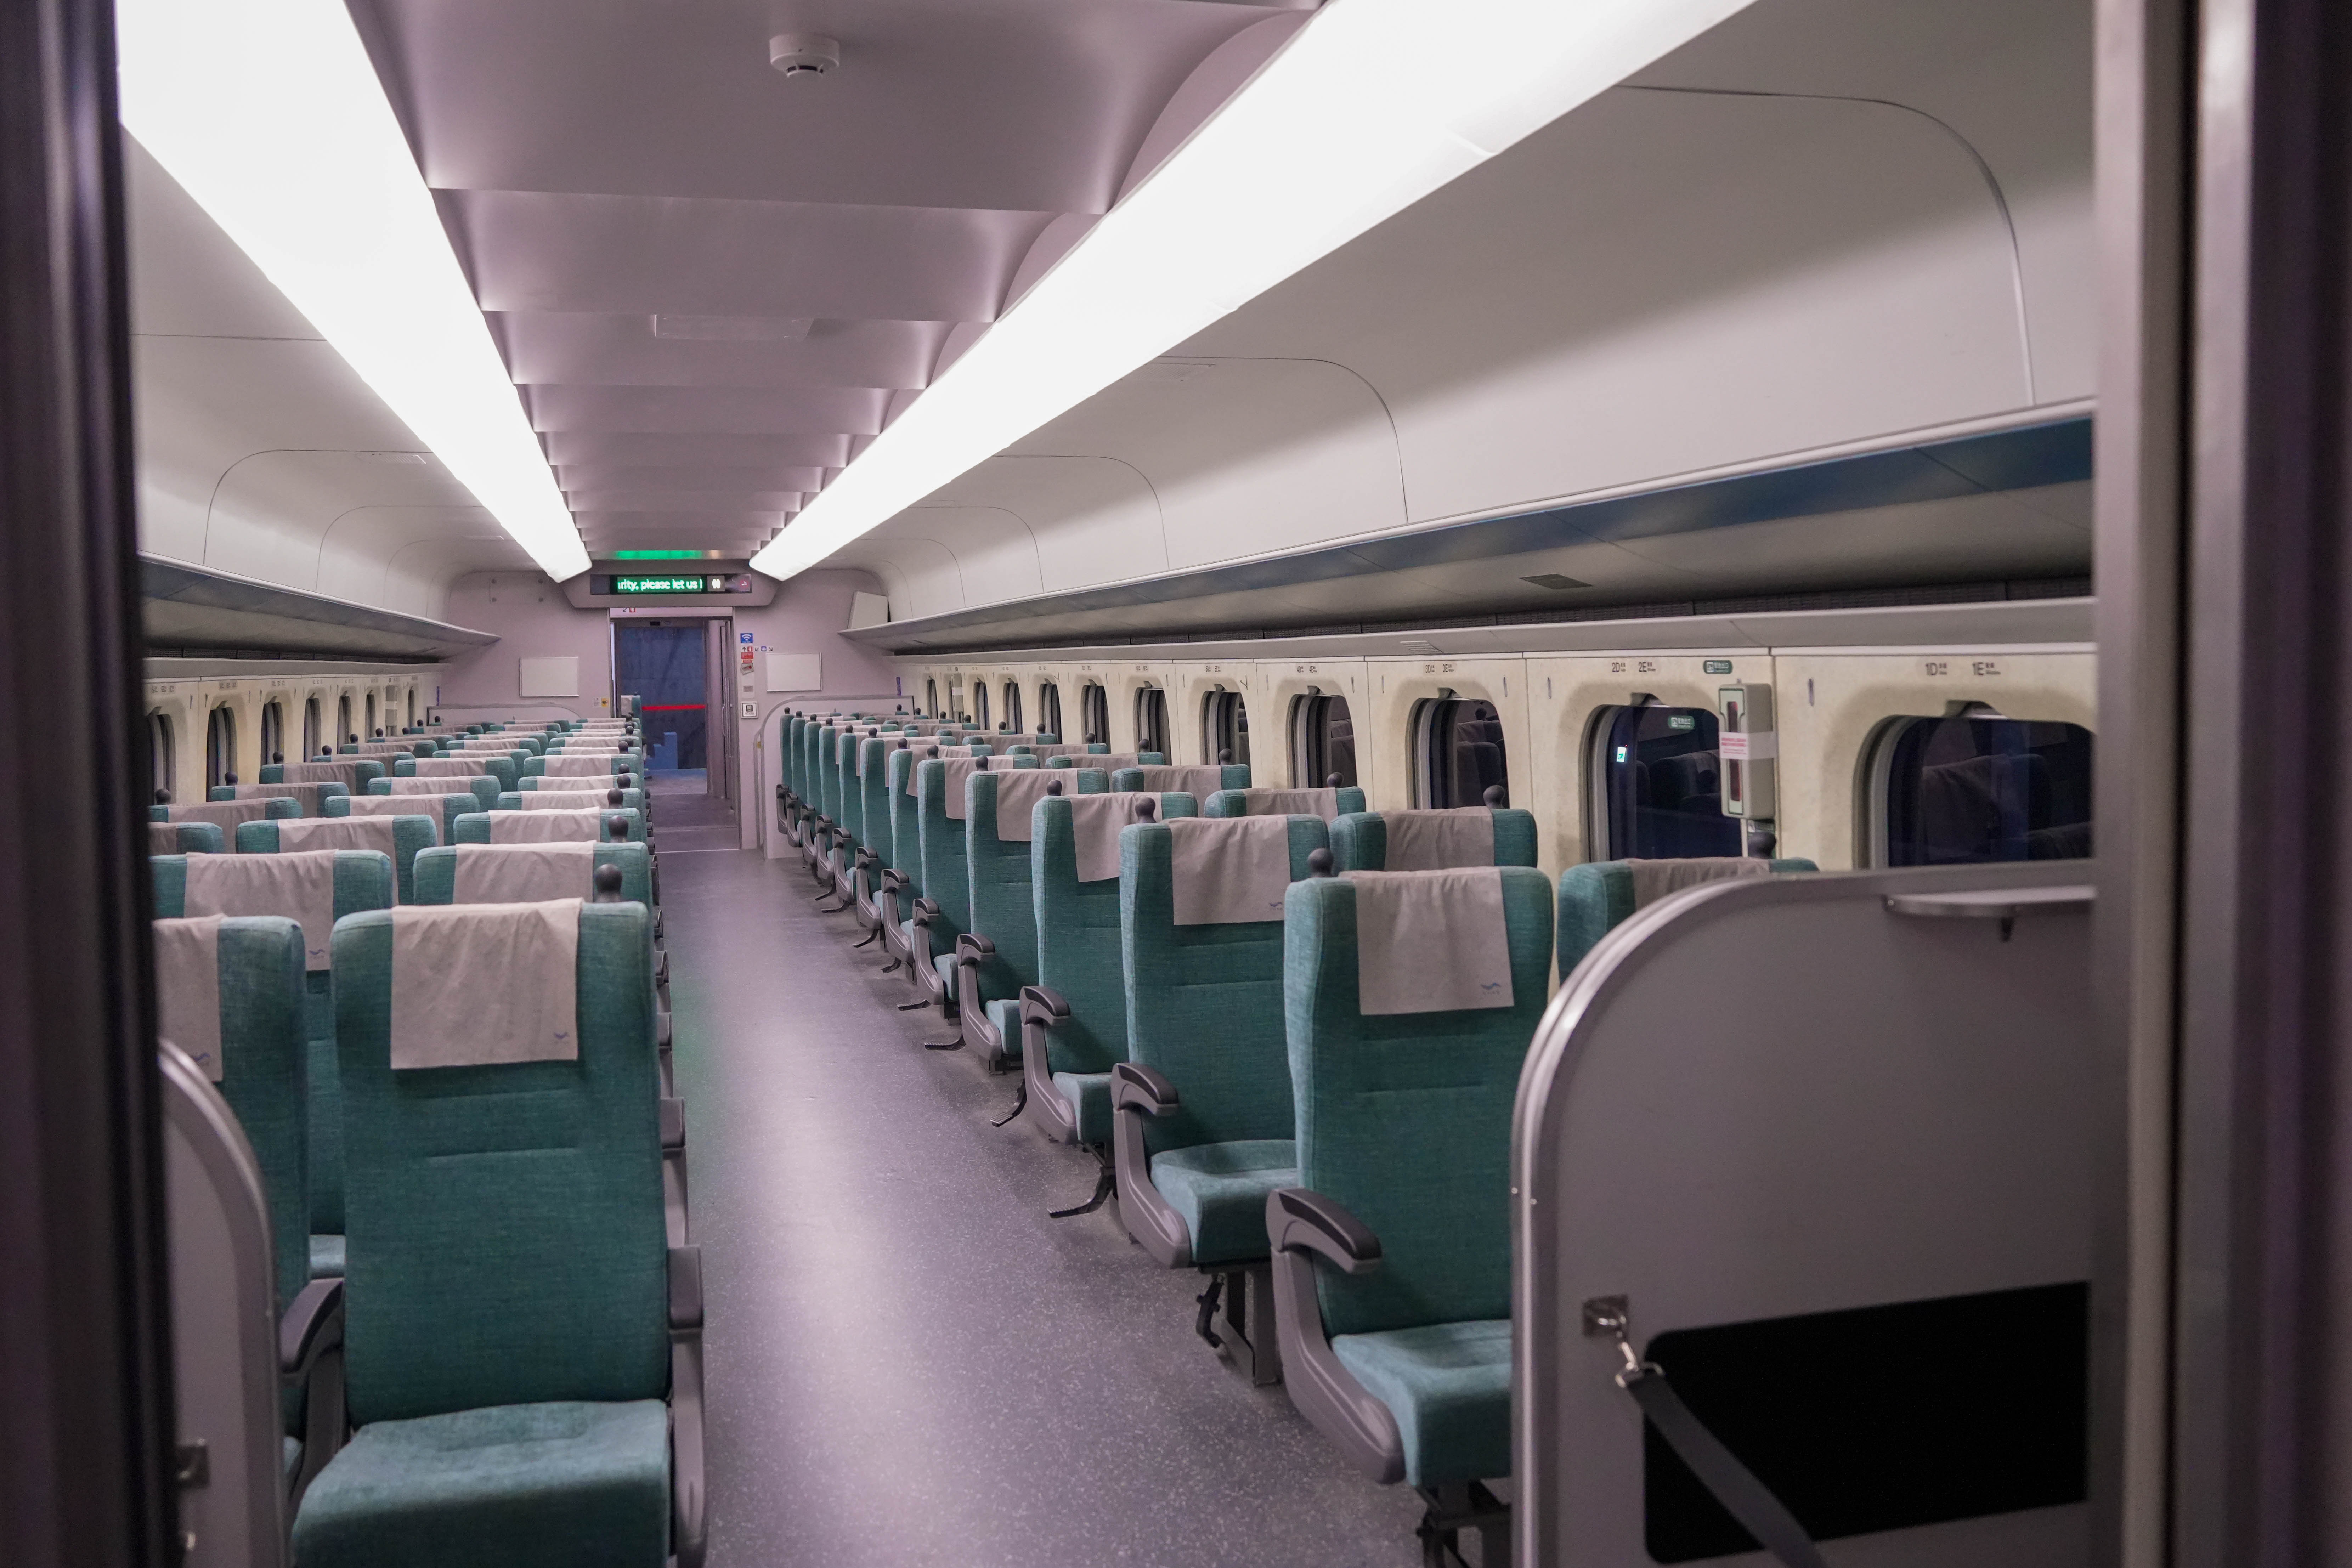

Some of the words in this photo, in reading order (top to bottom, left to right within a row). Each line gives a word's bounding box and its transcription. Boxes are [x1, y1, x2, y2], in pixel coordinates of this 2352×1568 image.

[640, 579, 670, 591] please
[672, 579, 685, 589] let
[686, 581, 698, 589] us
[1425, 664, 1431, 673] 3D
[1442, 664, 1448, 672] 3E
[1611, 662, 1620, 672] 2D
[1638, 662, 1647, 672] 2E
[1925, 662, 1938, 676] 1D
[1972, 662, 1984, 676] 1E
